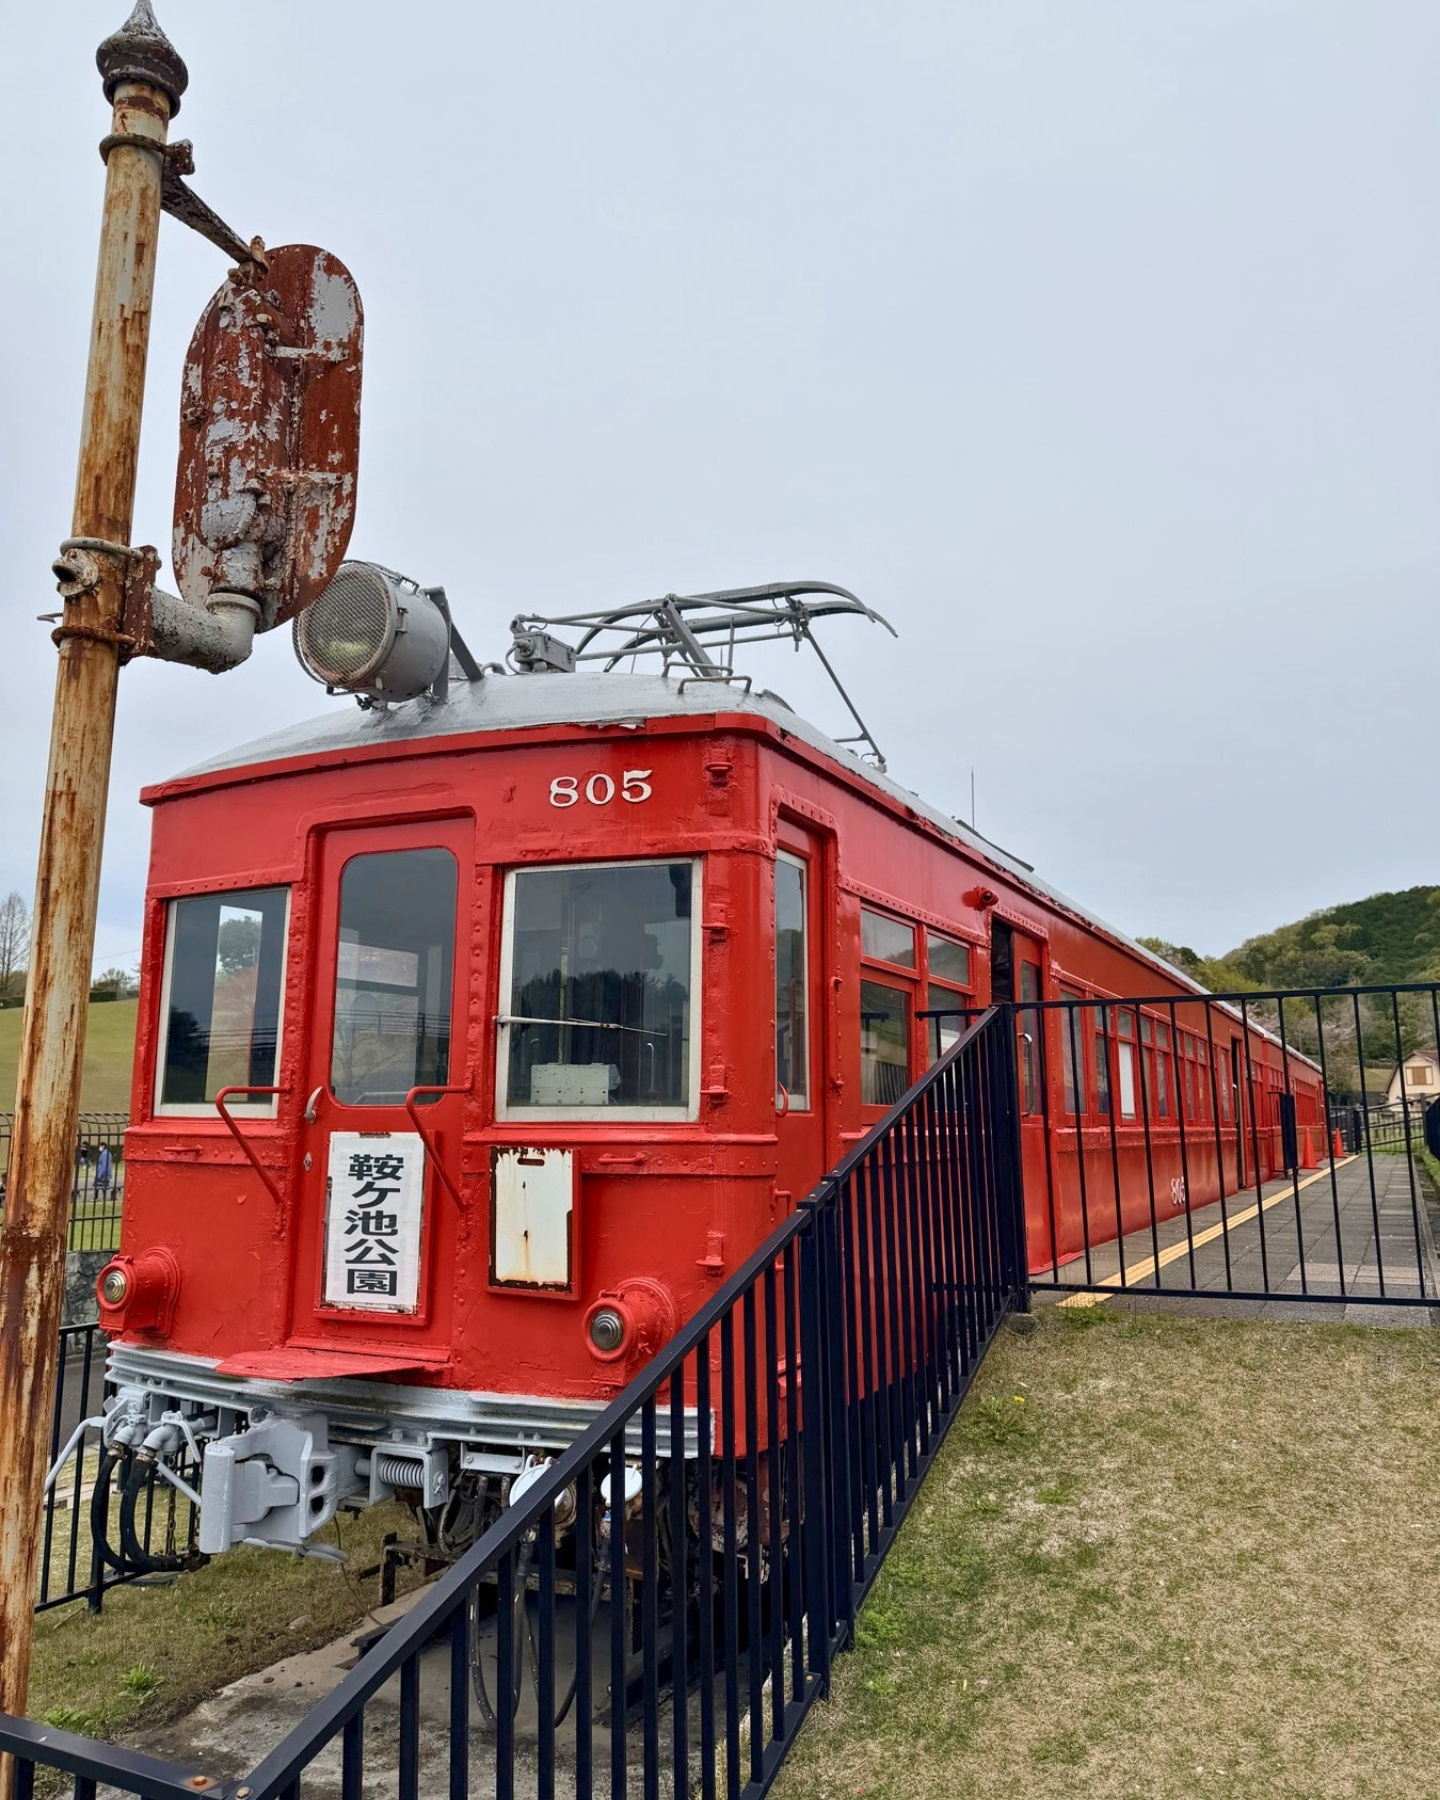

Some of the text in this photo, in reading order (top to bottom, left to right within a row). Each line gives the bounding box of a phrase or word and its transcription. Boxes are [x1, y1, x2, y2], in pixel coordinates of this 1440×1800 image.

[549, 769, 653, 808] 805
[344, 1153, 404, 1297] 鞍ケ池公園
